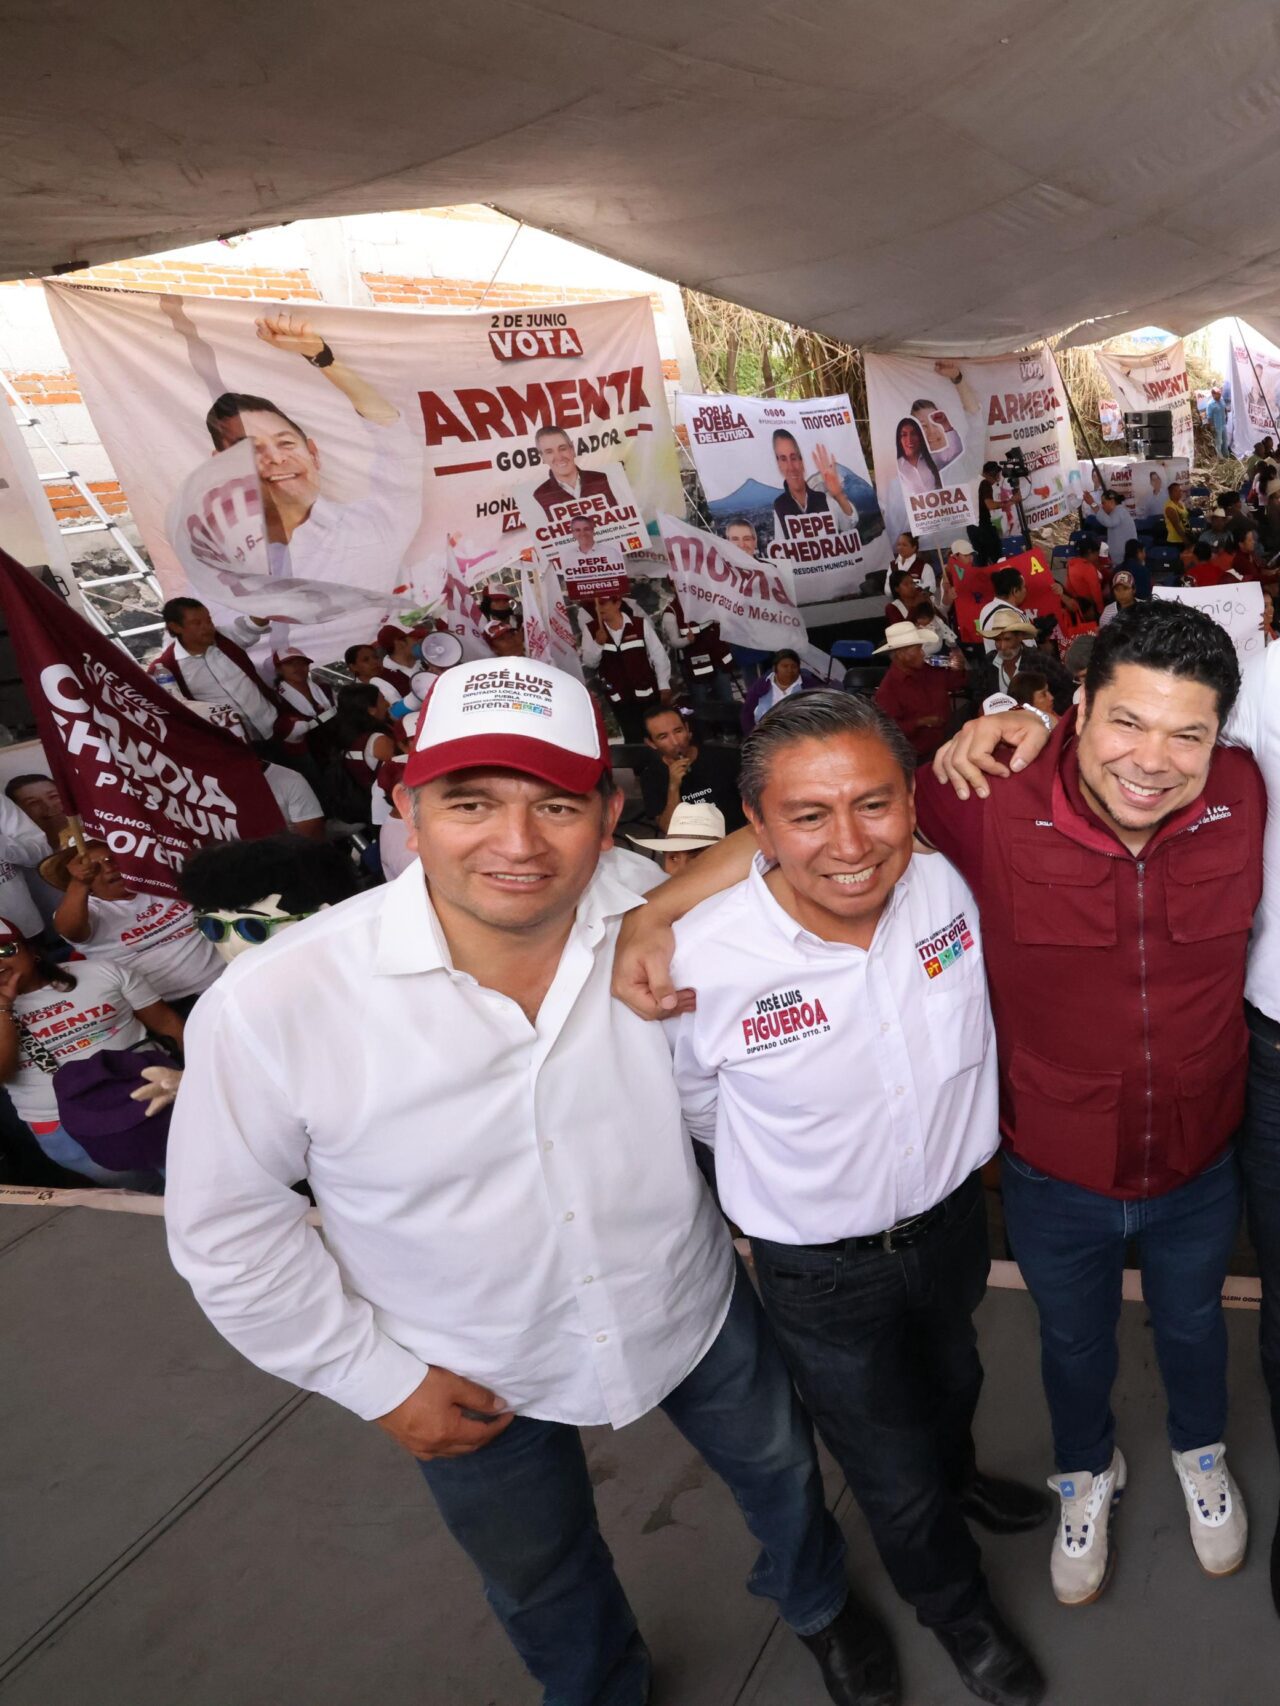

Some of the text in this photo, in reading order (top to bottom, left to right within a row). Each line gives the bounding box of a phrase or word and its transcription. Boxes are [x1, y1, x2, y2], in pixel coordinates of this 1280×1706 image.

[491, 313, 567, 328] 2 DE JUNIO
[490, 330, 582, 357] VOTA
[418, 366, 651, 446] ARMENTA
[699, 404, 732, 418] POR LA
[692, 413, 748, 433] PUEBLA
[801, 412, 845, 430] morena
[699, 429, 750, 443] DEL FUTURO
[496, 428, 622, 472] GOBADOR
[553, 497, 606, 521] PEPE
[909, 487, 967, 512] NORA
[535, 505, 638, 541] CHERAUI
[914, 504, 970, 521] ESCAMILLA
[788, 514, 836, 540] PEPE
[769, 532, 861, 562] CHEDRAUI
[565, 562, 625, 576] CHEDRAUI
[578, 556, 608, 567] PEPE
[824, 560, 855, 571] MUNICIPAL
[577, 580, 612, 591] morena
[689, 584, 733, 611] speranza
[749, 606, 801, 628] México
[93, 662, 120, 686] DE
[466, 668, 553, 689] JOSÉ LUIS
[462, 689, 498, 699] DIPUTADO
[464, 680, 552, 697] FIGUEROA
[462, 701, 510, 713] morena
[682, 788, 712, 802] Primero
[918, 919, 968, 960] morena
[927, 963, 940, 977] PT
[756, 989, 803, 1015] JOSÉ LUIS
[32, 1003, 116, 1039] MENTA
[742, 998, 828, 1046] FIGUEROA
[747, 1042, 777, 1055] DIPUTADO
[780, 1035, 801, 1045] LOCAL
[803, 1028, 821, 1038] DTTO.
